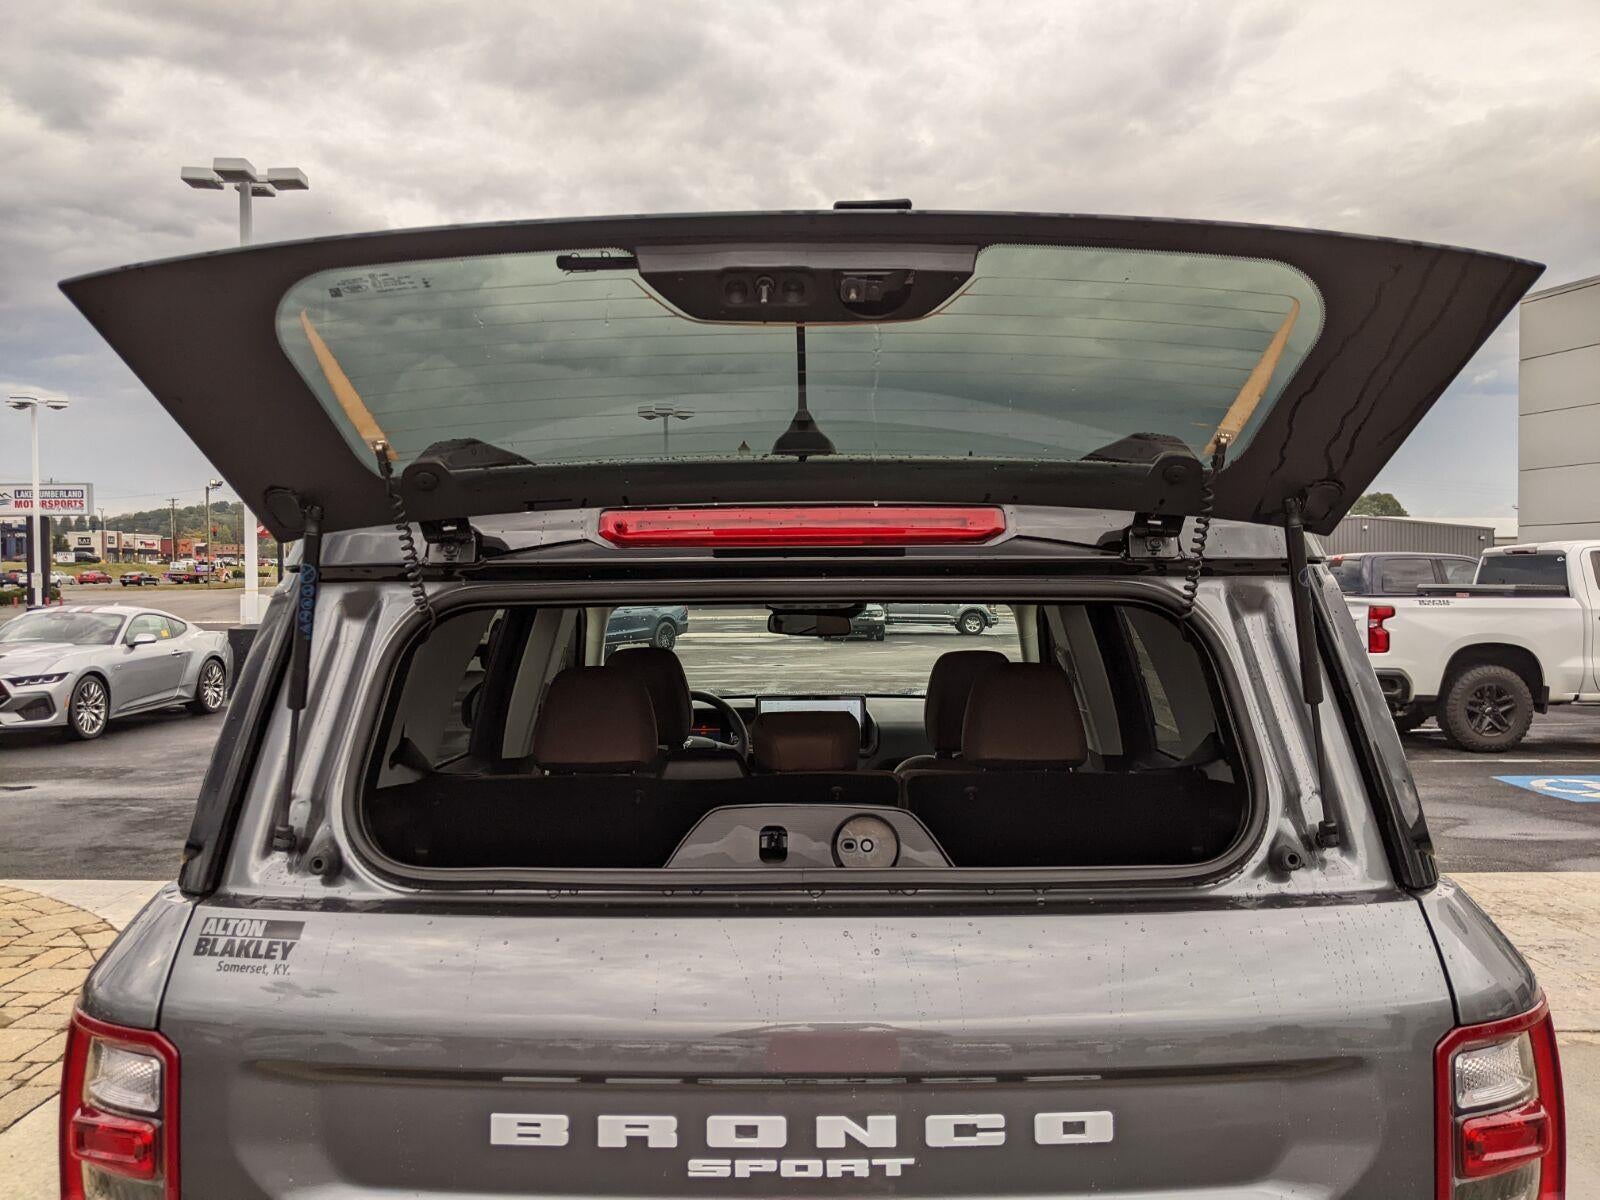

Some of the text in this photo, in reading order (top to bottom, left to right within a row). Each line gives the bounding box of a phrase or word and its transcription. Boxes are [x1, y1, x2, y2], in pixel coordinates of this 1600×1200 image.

[15, 490, 82, 498] LAKE UMBERLAND
[14, 500, 84, 508] MOTRSPORTS
[202, 918, 268, 937] ALTON
[193, 938, 297, 960] BLAKLEY
[216, 960, 290, 976] Somerset, KY.
[490, 1111, 1114, 1148] BRONCO
[688, 1158, 915, 1177] SPORT
